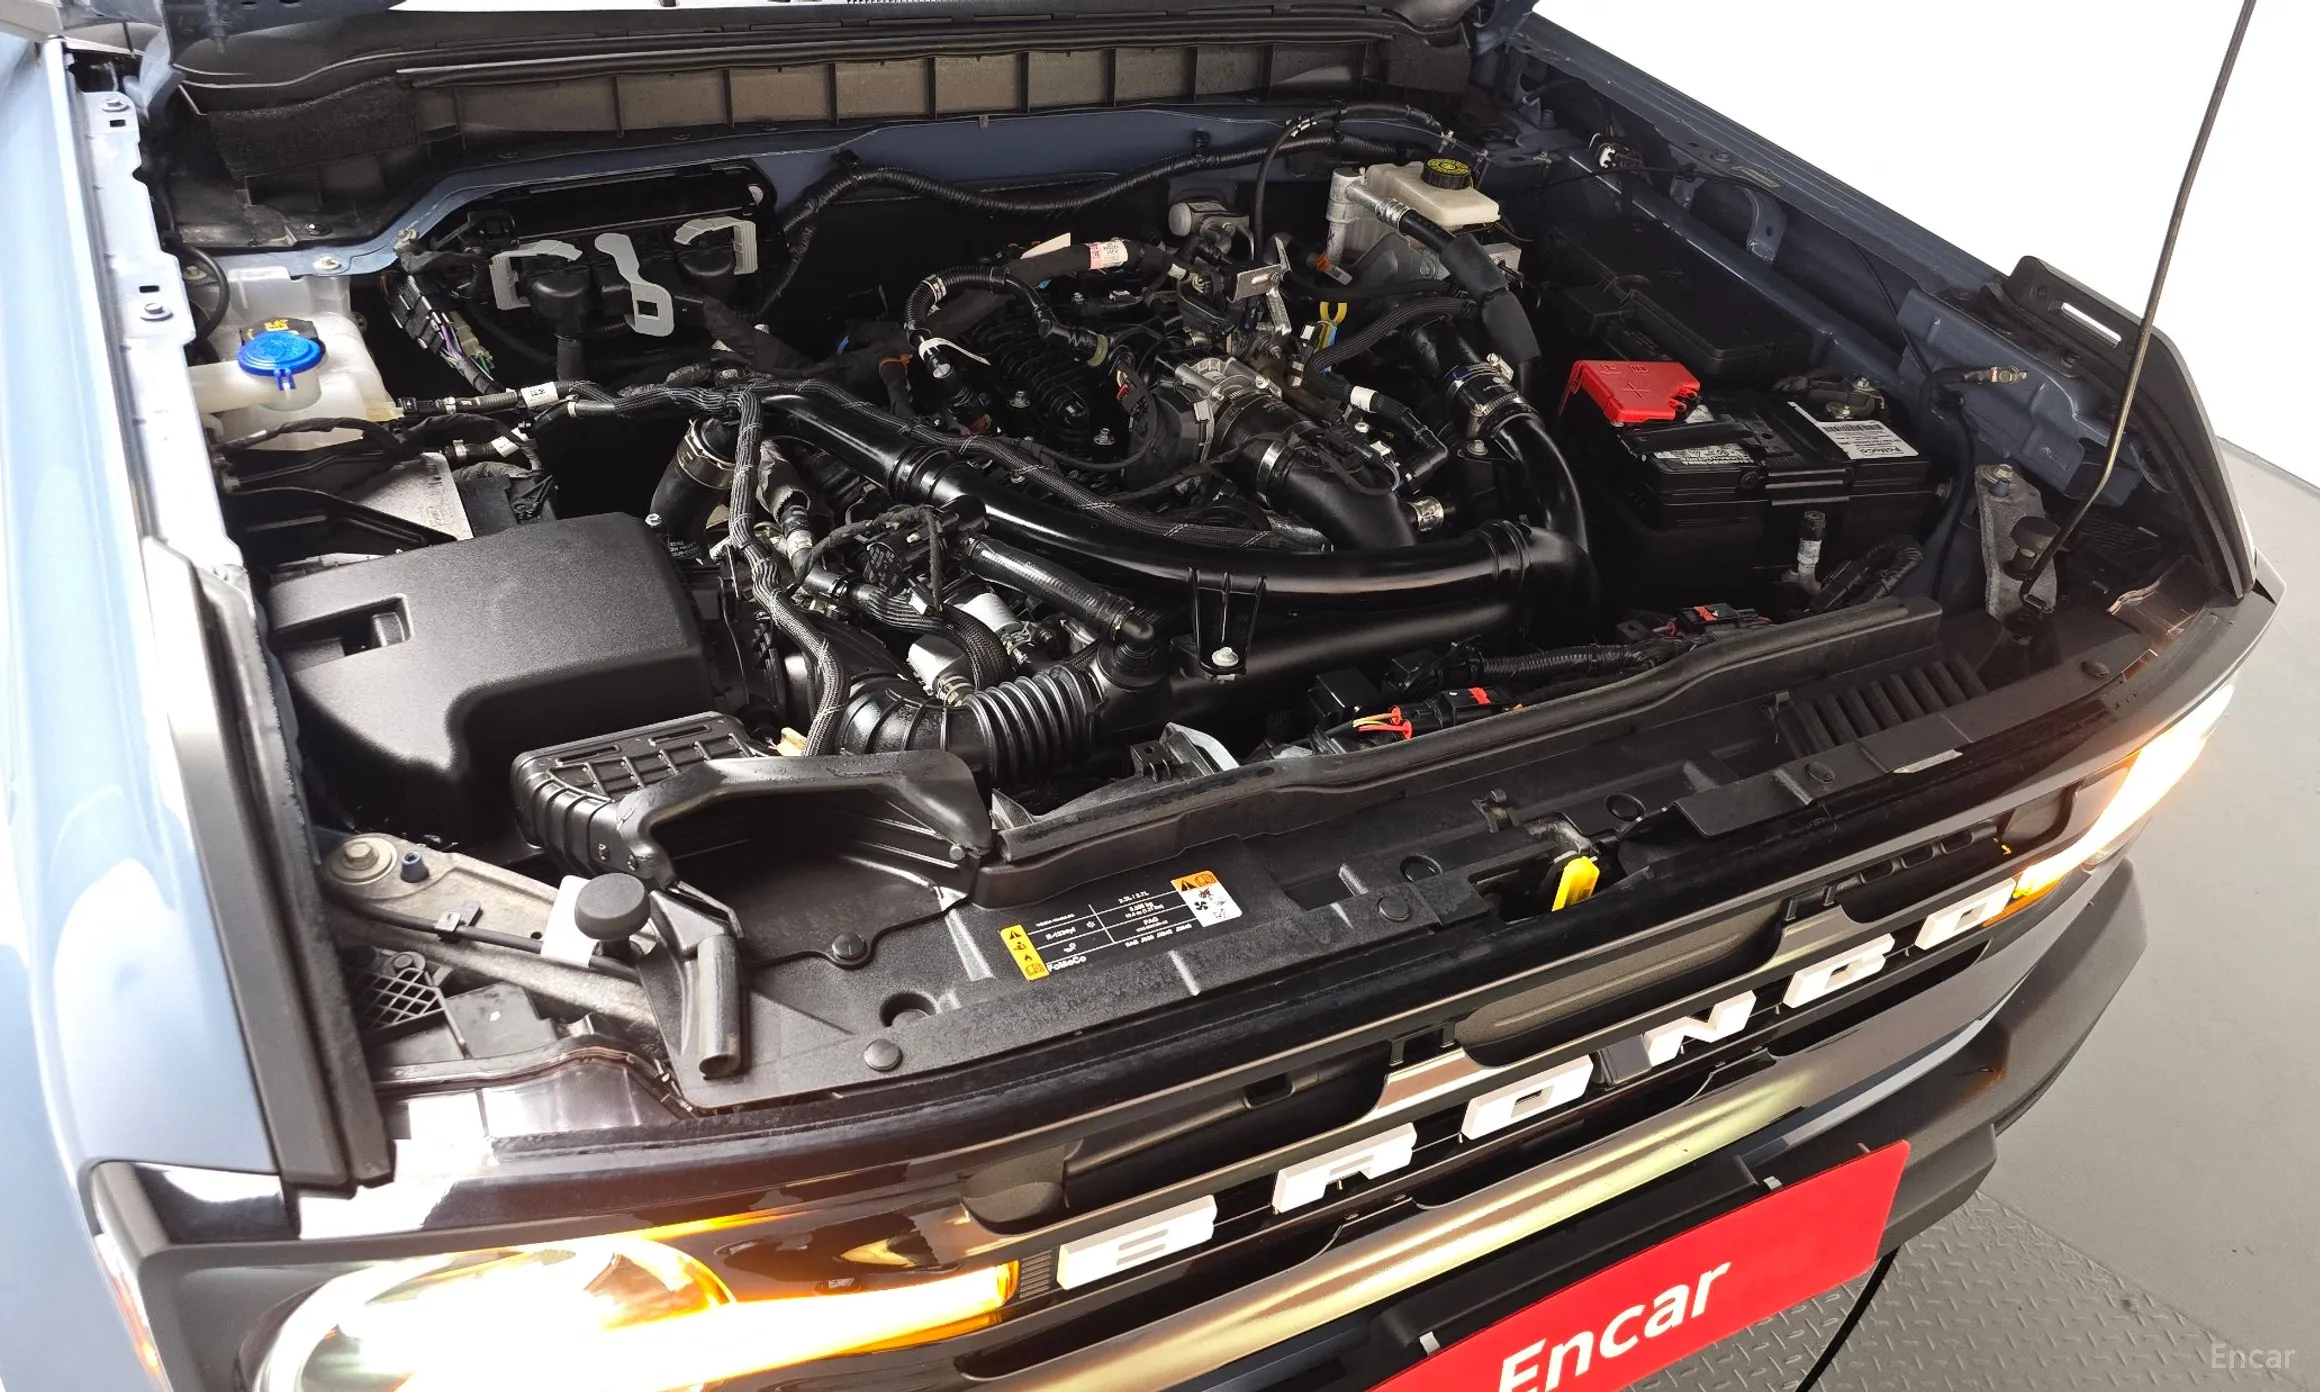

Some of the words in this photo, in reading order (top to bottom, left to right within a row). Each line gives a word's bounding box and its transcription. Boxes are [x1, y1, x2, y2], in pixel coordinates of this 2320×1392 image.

[1046, 956, 1087, 972] FoMoCo
[1057, 878, 2017, 1290] BRONCO
[1499, 1262, 1732, 1392] Encar
